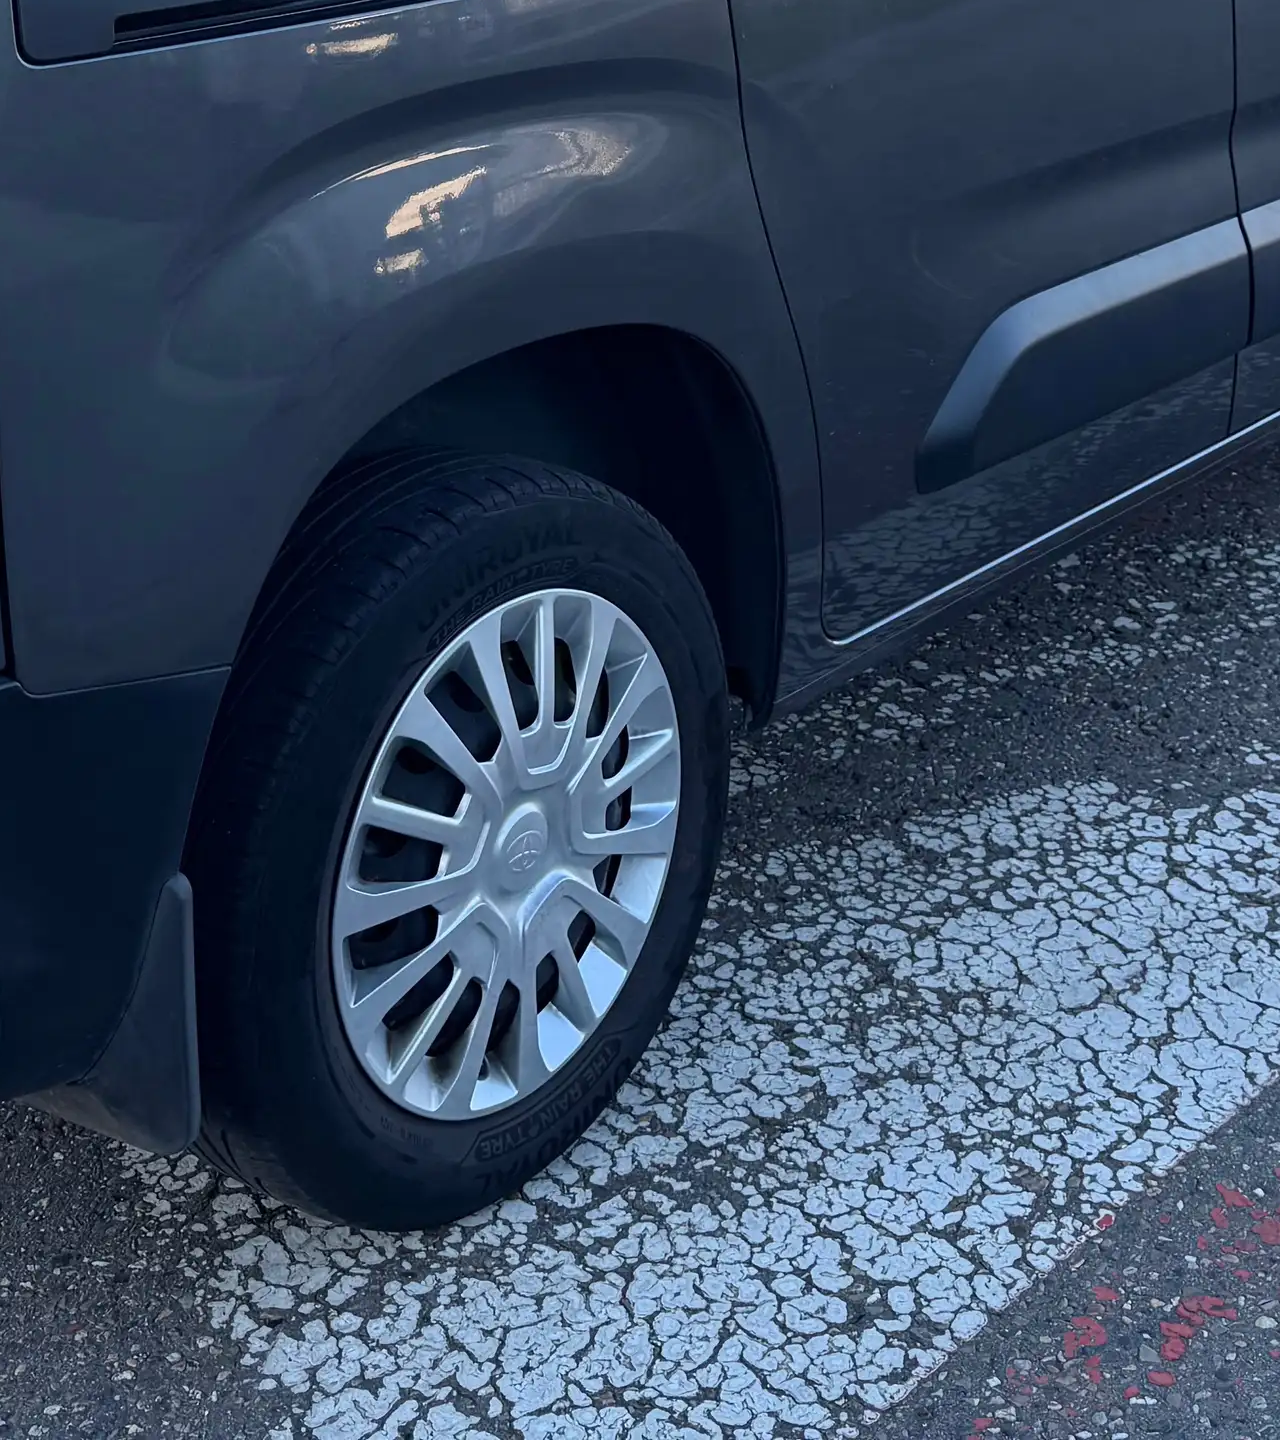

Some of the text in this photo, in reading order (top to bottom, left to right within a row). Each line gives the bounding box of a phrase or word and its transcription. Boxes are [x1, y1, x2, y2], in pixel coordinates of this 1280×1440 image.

[432, 558, 576, 646] THE RAIN TYRE
[585, 1045, 618, 1086] THE
[538, 1085, 584, 1130] RAIN
[480, 1126, 532, 1159] TYRE
